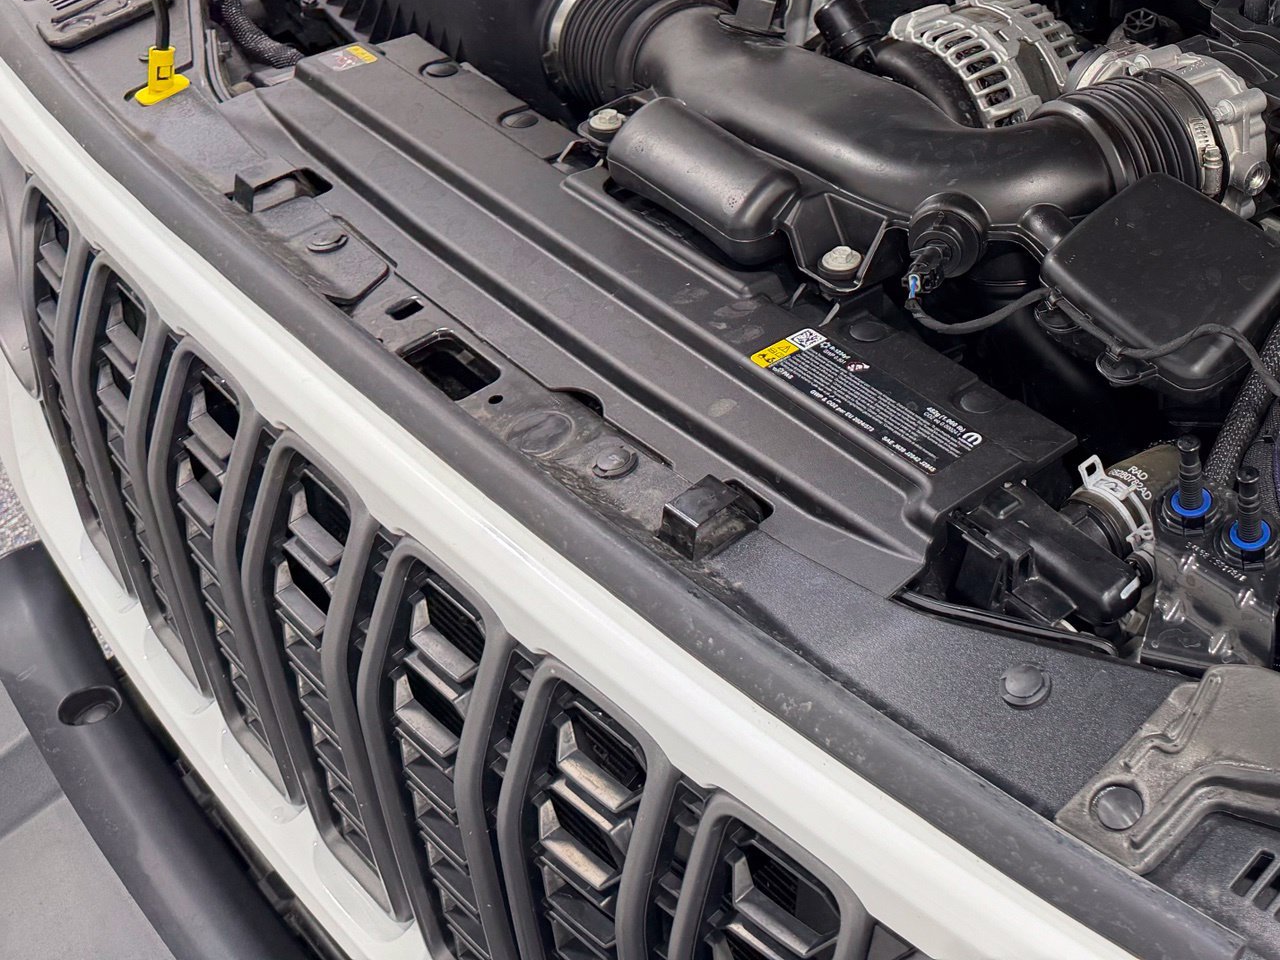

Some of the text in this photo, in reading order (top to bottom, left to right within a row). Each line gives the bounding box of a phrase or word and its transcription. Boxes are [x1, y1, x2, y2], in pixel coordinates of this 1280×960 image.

[810, 390, 823, 398] GWP
[881, 436, 895, 445] SAE
[1127, 465, 1148, 481] RAD
